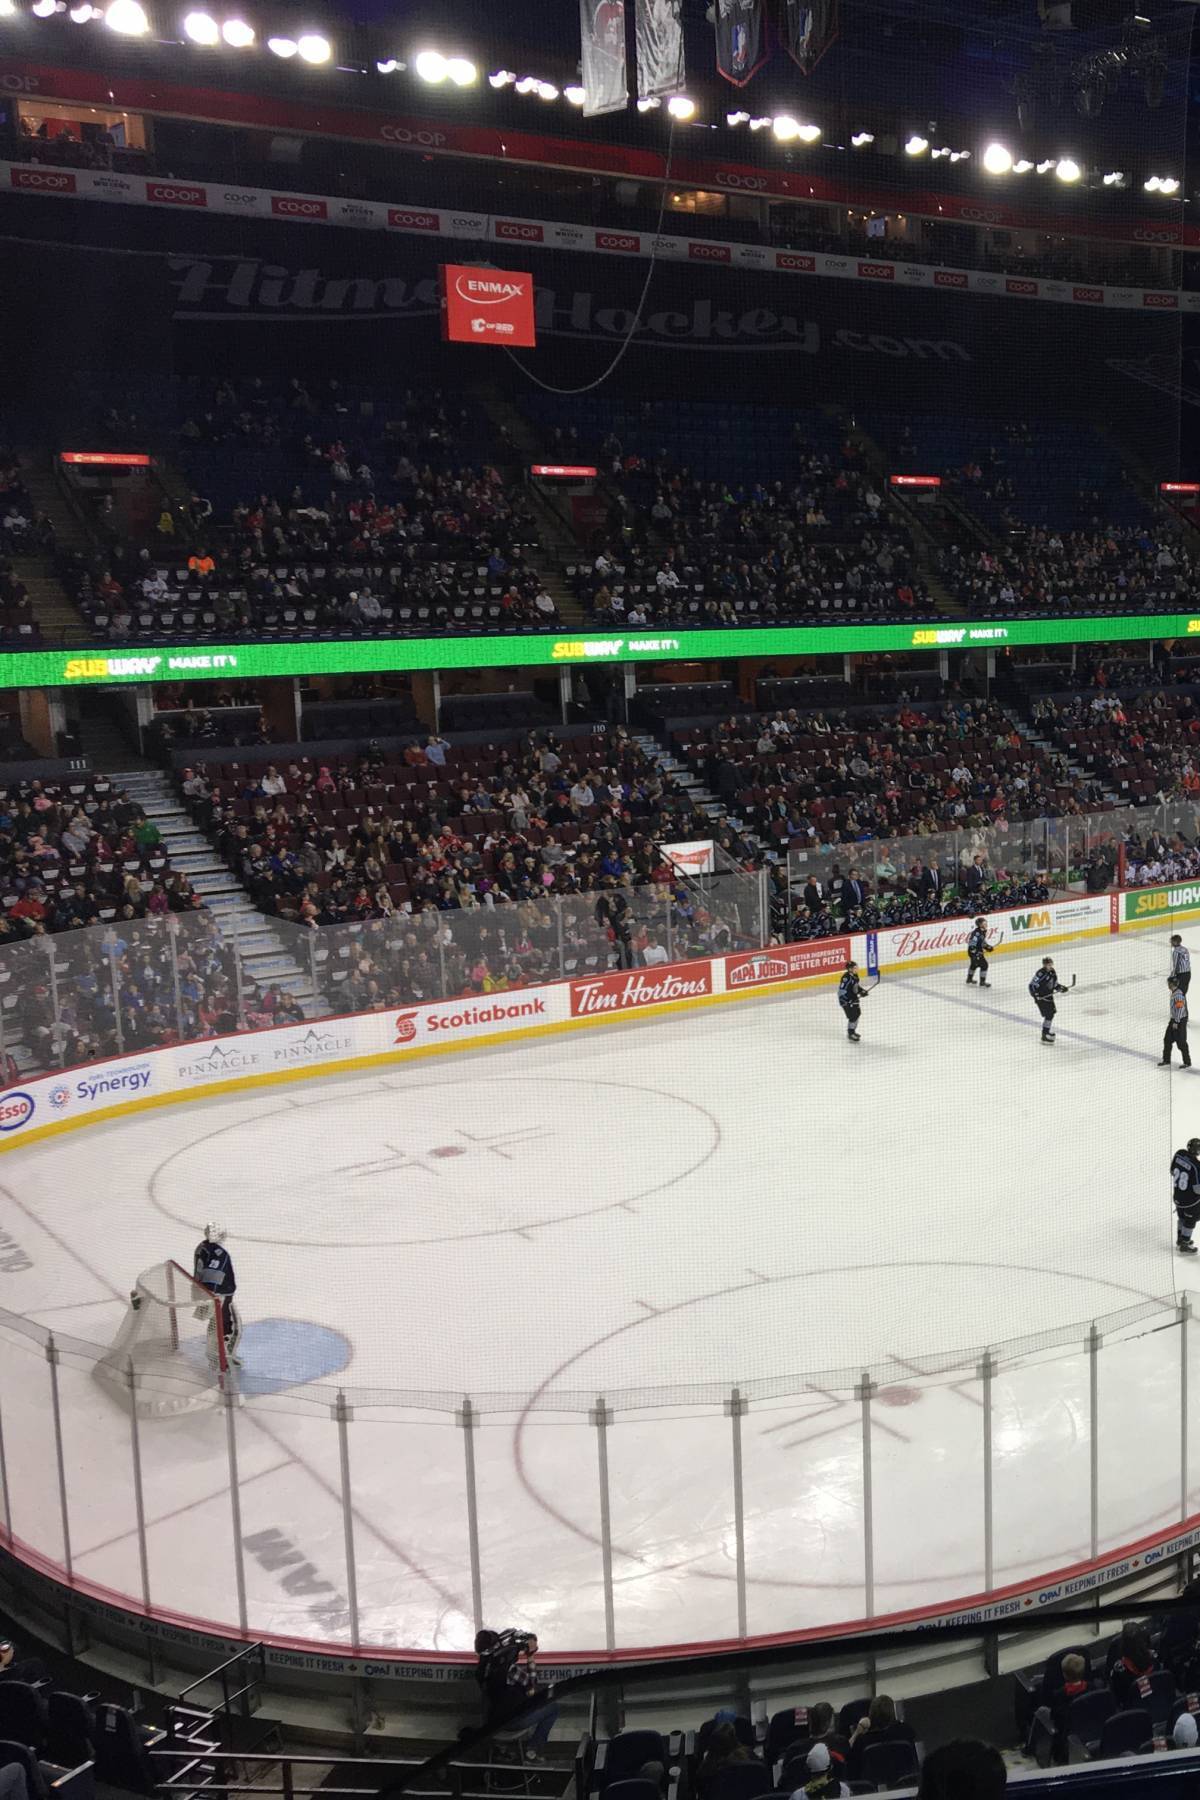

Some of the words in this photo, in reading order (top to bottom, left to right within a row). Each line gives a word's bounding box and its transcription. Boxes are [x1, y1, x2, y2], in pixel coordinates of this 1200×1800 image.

[380, 125, 447, 147] CO-OP
[19, 173, 69, 188] CO-OP
[715, 172, 768, 190] CO-OP
[153, 188, 200, 203] CO-OP
[278, 200, 320, 215] CO-OP
[394, 213, 434, 227] CO-OP
[501, 225, 539, 238] CO-OP
[601, 236, 636, 249] CO-OP
[693, 246, 727, 259] CO-OP
[780, 256, 813, 269] CO-OP
[862, 265, 891, 277] CO-OP
[467, 280, 524, 296] ENMAX
[552, 640, 623, 658] SUBWAY
[629, 640, 660, 651] MAKE
[63, 656, 162, 678] SUBWAY
[168, 656, 211, 669] MAKE
[1010, 911, 1050, 931] WM
[790, 953, 811, 963] BETTER
[790, 959, 821, 971] BETTER
[732, 965, 756, 983] PAPA
[574, 979, 618, 1013] Tim
[621, 974, 706, 1004] Hortons
[426, 998, 546, 1032] Scotiabank
[273, 1037, 352, 1060] PINNACLE
[178, 1053, 260, 1078] PINNACLE
[76, 1069, 152, 1101] Synergy
[1166, 1535, 1193, 1554] KEEPING
[1194, 1532, 1200, 1544] IT
[1064, 1577, 1096, 1595] KEEPING
[1097, 1573, 1105, 1586] IT
[1106, 1563, 1129, 1582] FRESH
[268, 1652, 303, 1669] KEEPING
[305, 1655, 316, 1670] IT
[317, 1657, 344, 1673] FRESH
[394, 1666, 433, 1680] KEEPING
[435, 1667, 446, 1680] IT
